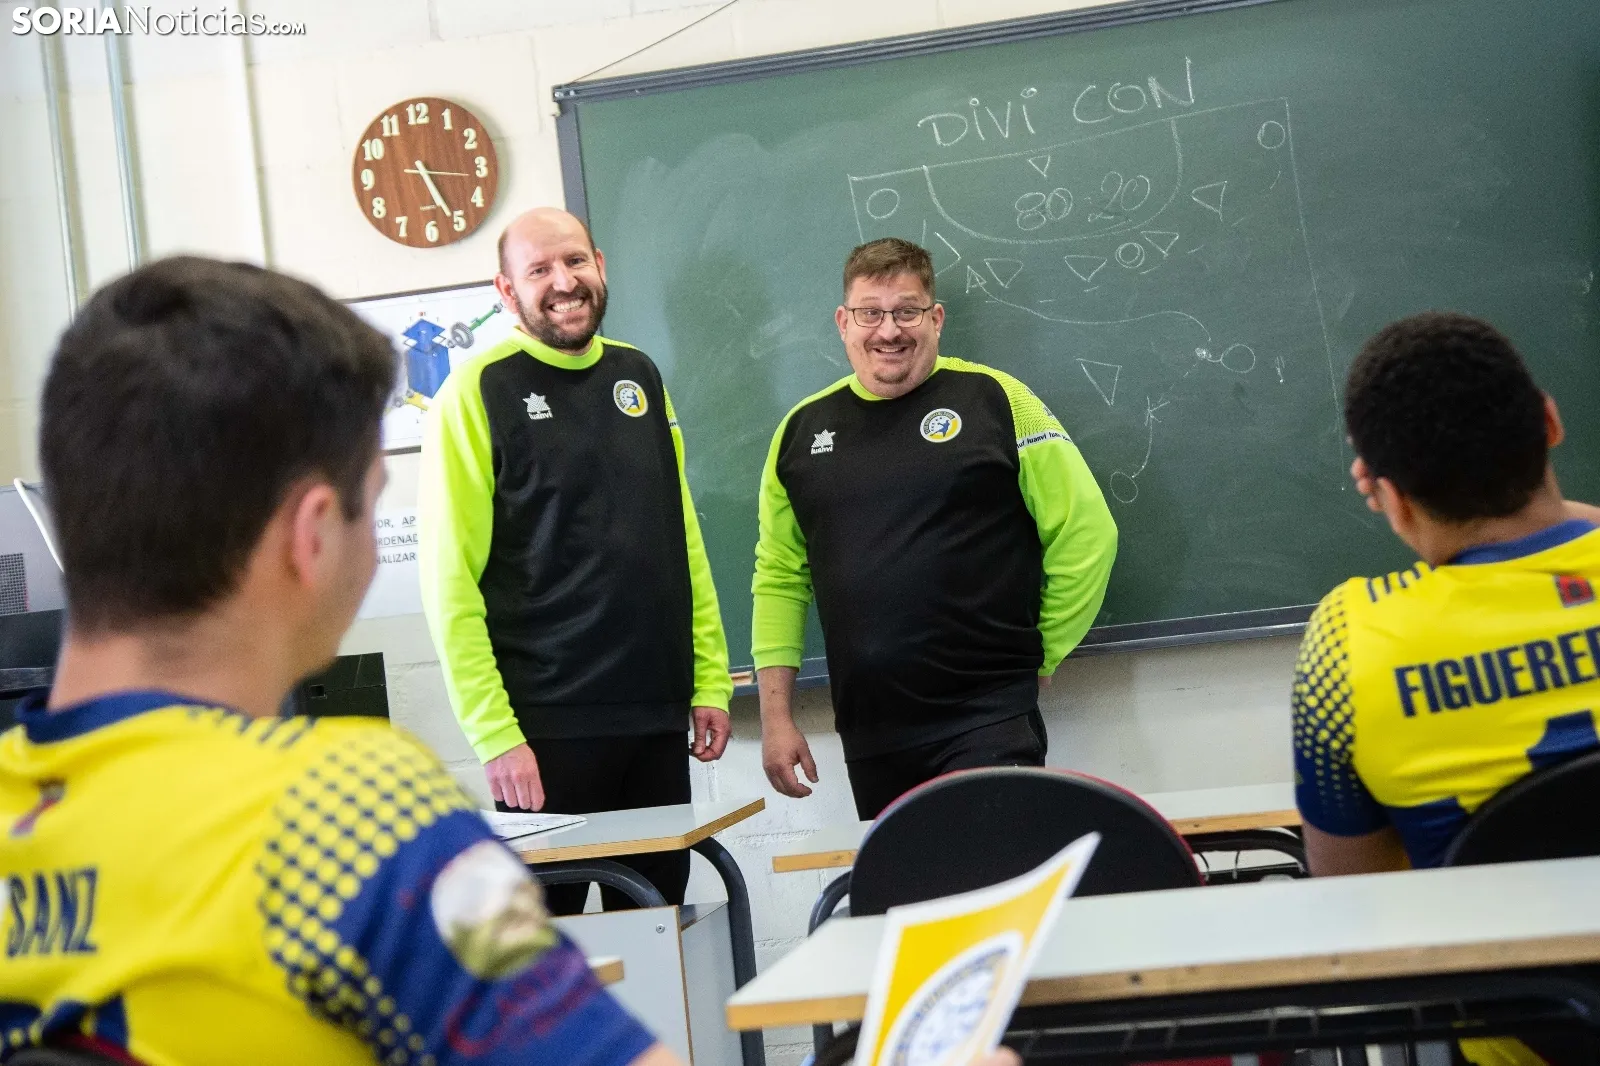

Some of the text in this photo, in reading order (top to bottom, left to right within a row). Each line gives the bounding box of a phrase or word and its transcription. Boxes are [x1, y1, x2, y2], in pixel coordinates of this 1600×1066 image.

[1073, 56, 1195, 124] CON
[406, 103, 430, 125] 12
[441, 108, 453, 130] 1
[381, 114, 400, 137] 11
[362, 138, 385, 161] 10
[463, 128, 478, 150] 2
[475, 156, 488, 178] 3
[360, 168, 375, 191] 9
[372, 197, 386, 219] 8
[471, 186, 484, 208] 4
[395, 216, 408, 237] 7
[425, 220, 439, 243] 6
[453, 209, 466, 232] 5
[6, 866, 99, 959] SANZ
